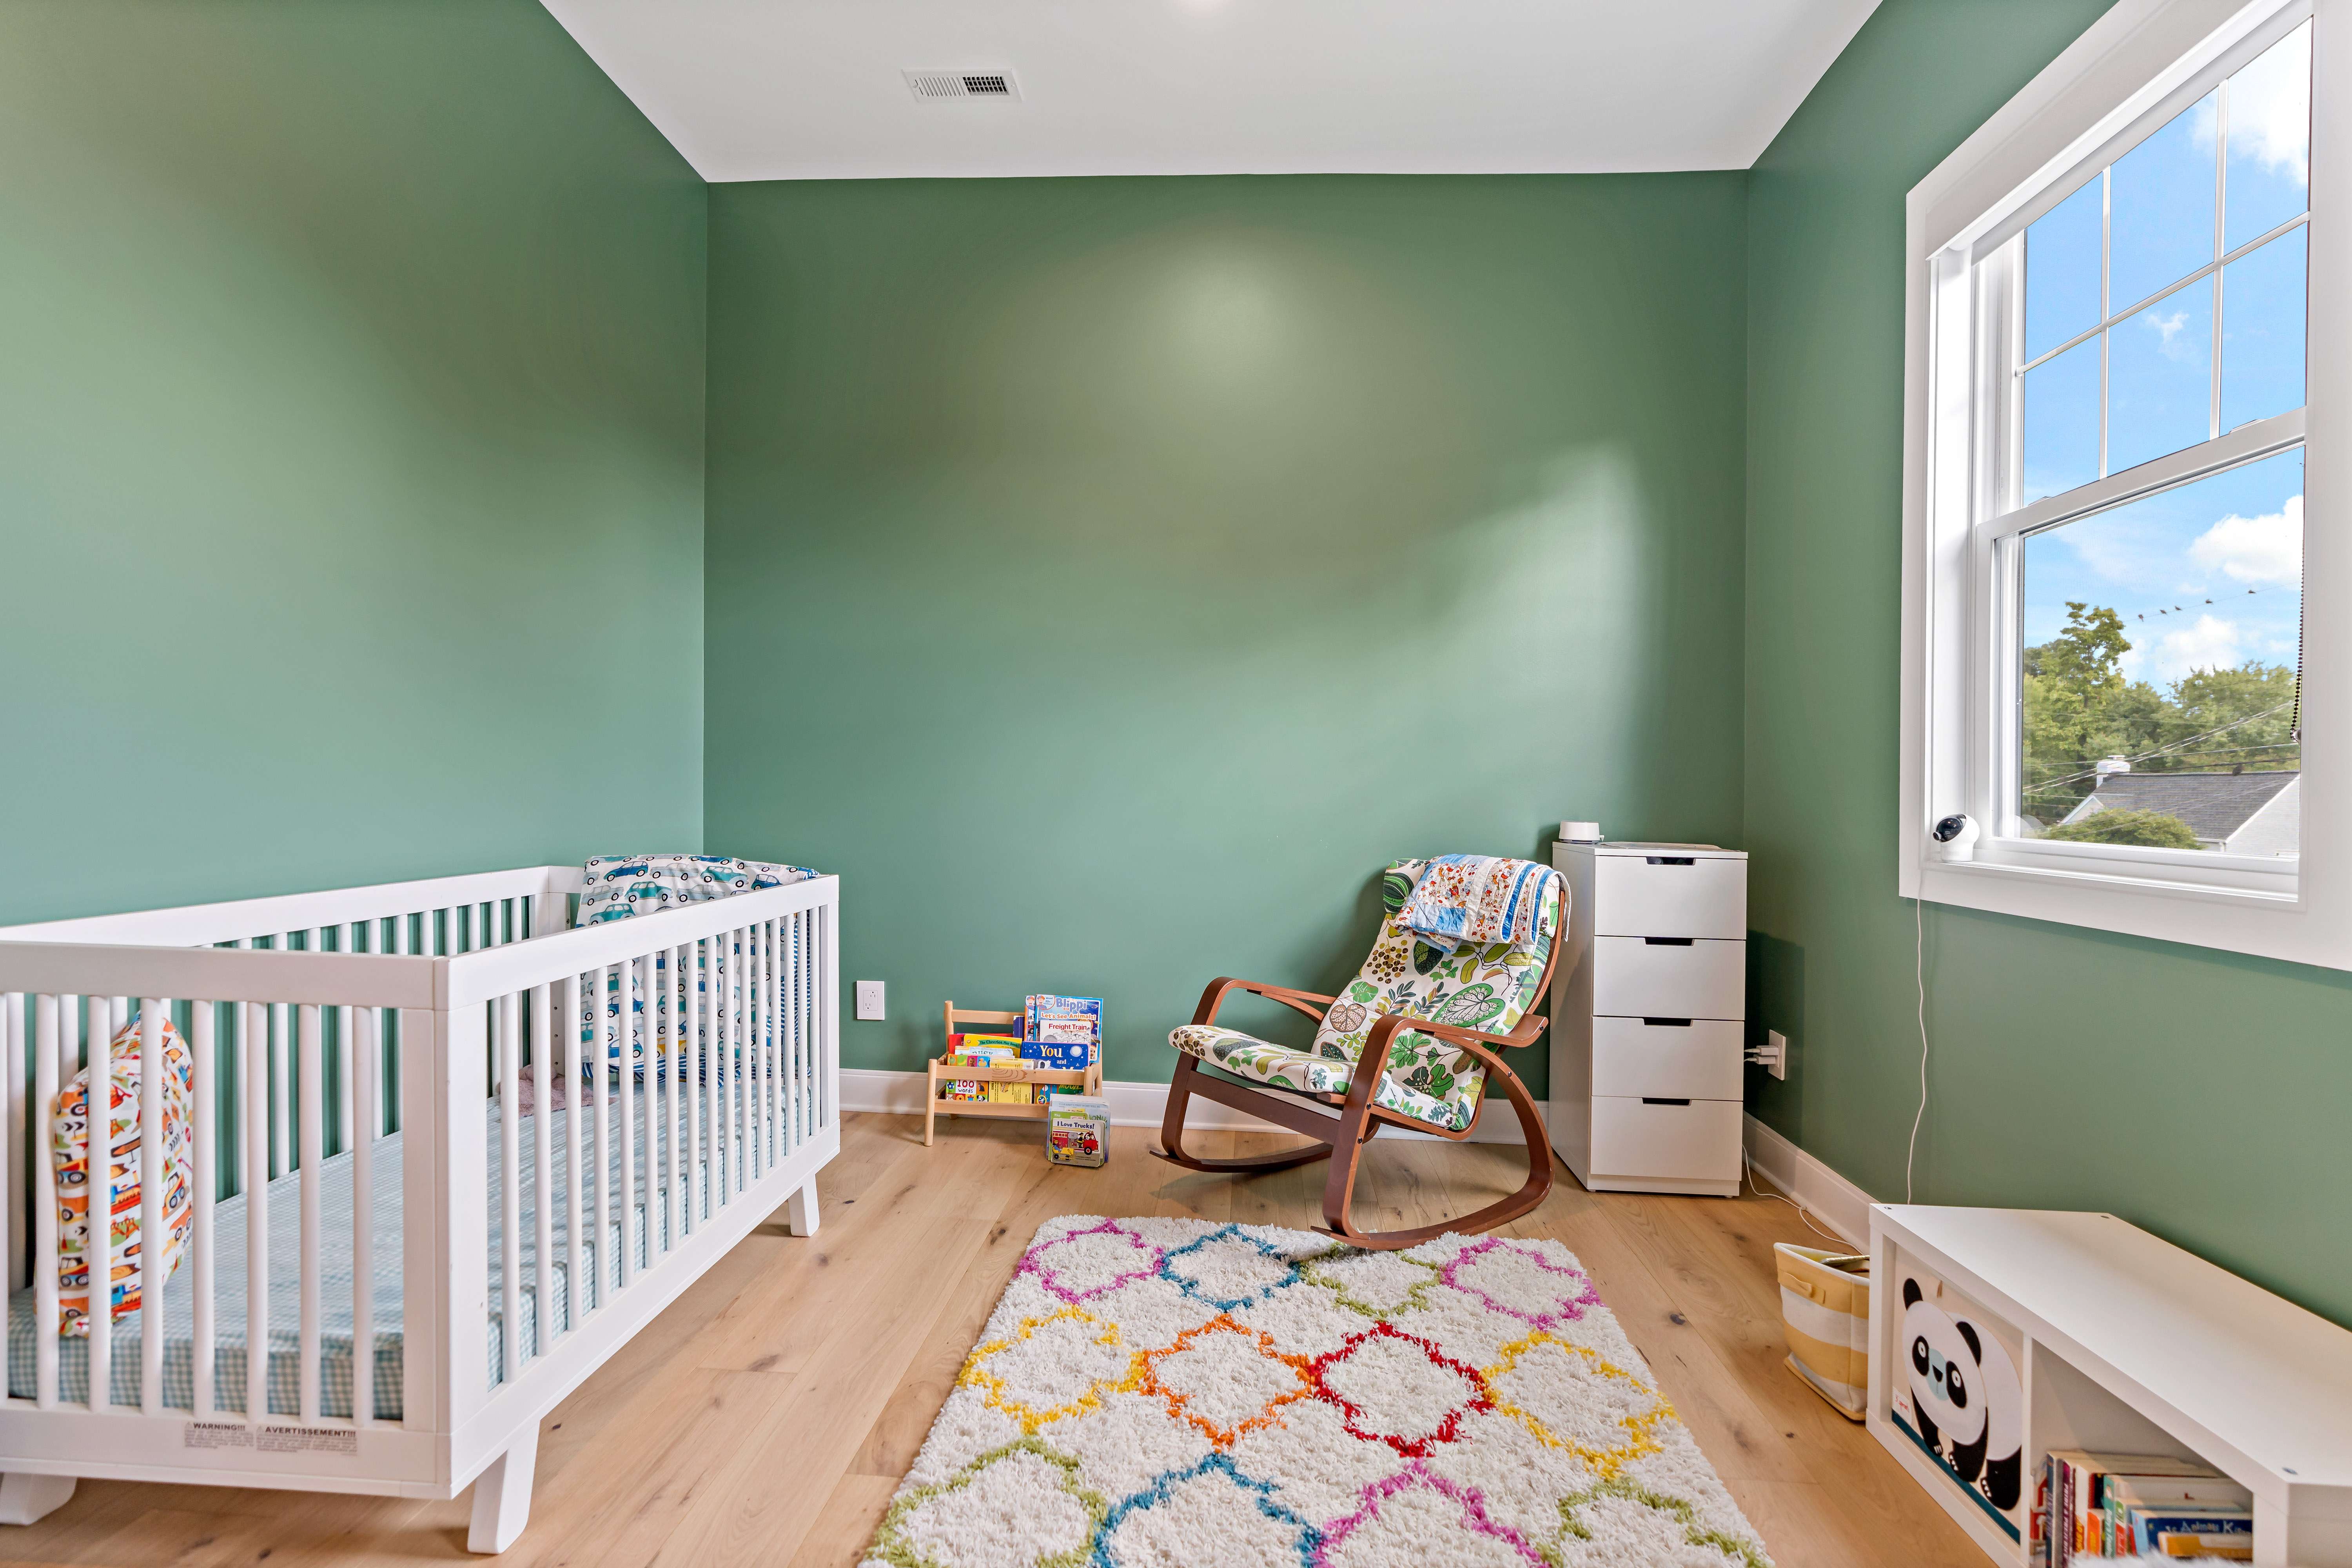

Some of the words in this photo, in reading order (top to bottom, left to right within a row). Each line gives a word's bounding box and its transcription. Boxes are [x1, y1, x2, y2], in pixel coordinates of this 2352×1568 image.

[1056, 998, 1086, 1012] Blippi
[1040, 1045, 1063, 1058] You
[957, 1079, 974, 1088] 100
[265, 1426, 356, 1437] AVERTISSEMENT!!!
